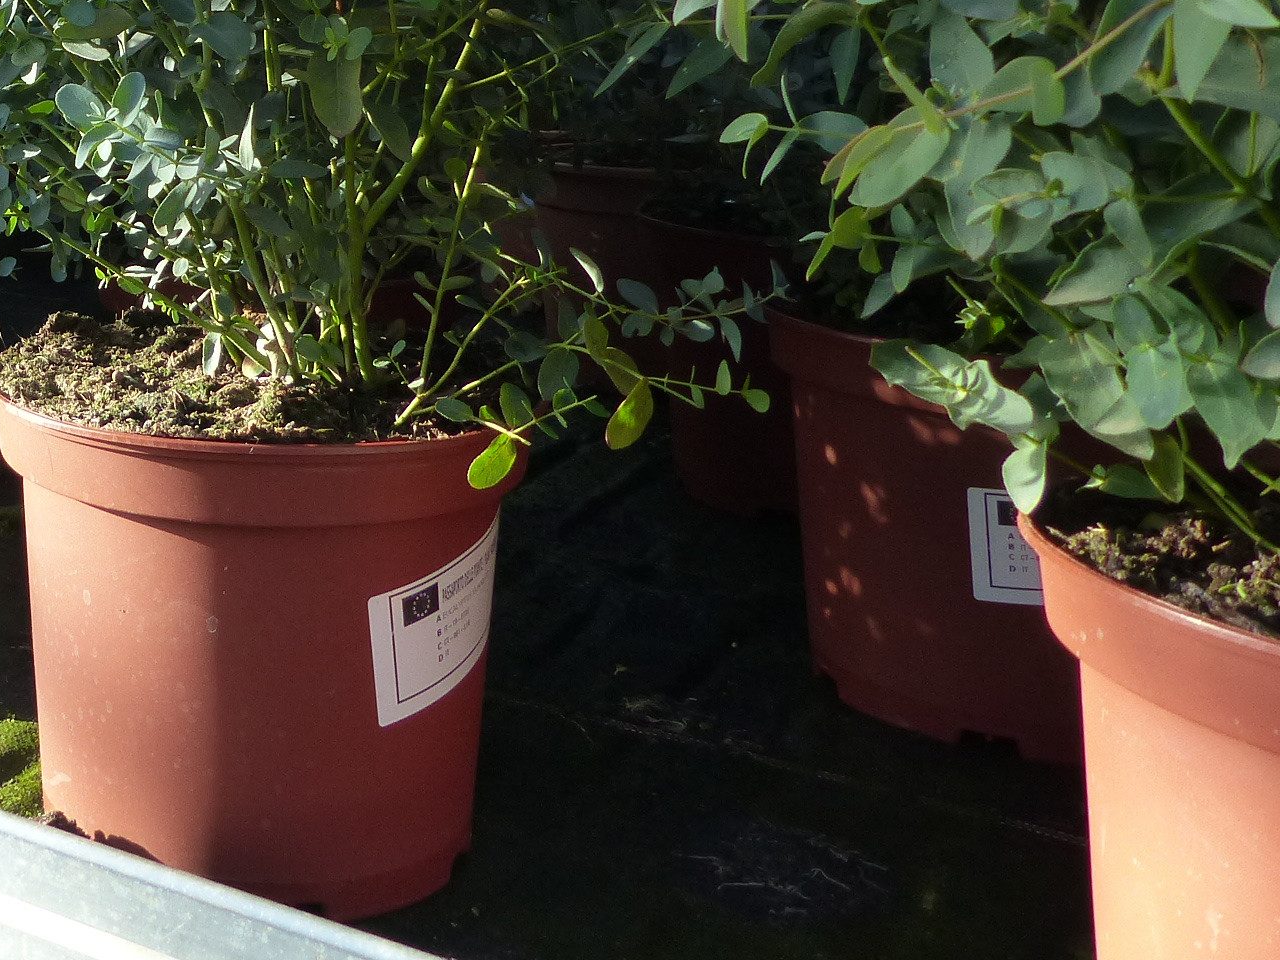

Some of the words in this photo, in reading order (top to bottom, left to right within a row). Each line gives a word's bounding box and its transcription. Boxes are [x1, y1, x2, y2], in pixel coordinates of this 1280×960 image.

[436, 614, 442, 623] A
[437, 628, 442, 637] B
[437, 641, 442, 651] C
[438, 653, 444, 663] D
